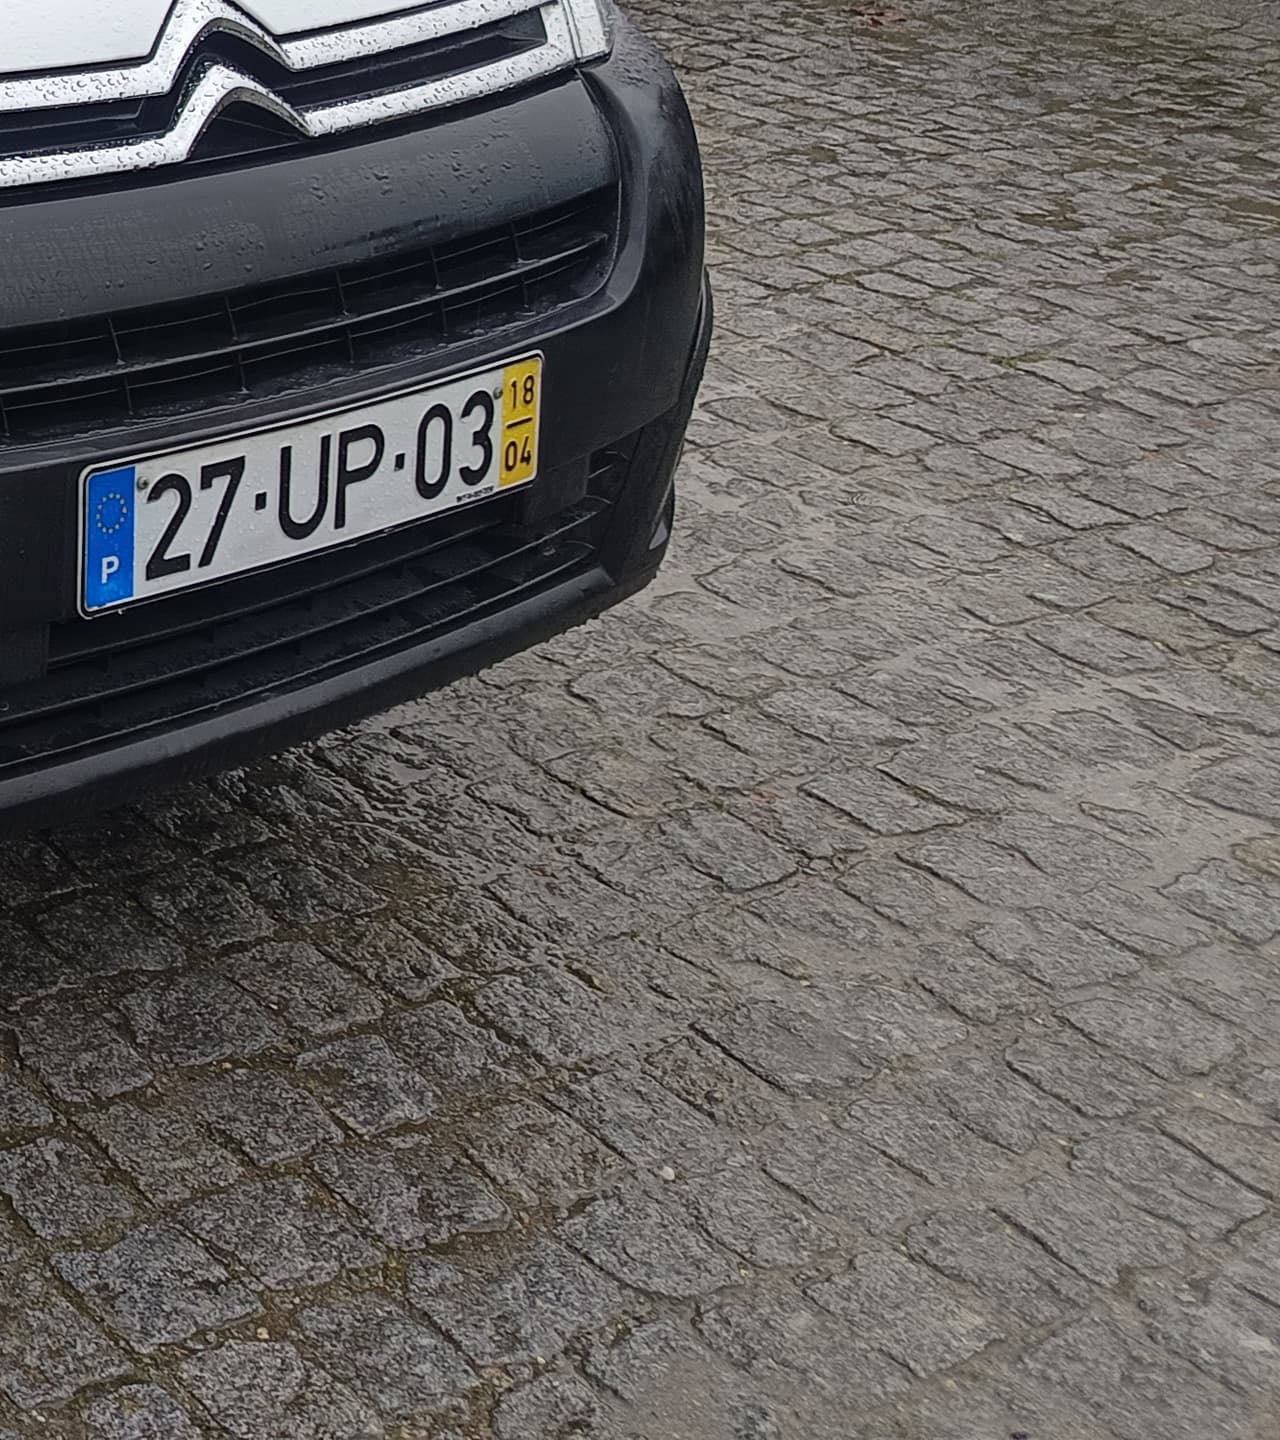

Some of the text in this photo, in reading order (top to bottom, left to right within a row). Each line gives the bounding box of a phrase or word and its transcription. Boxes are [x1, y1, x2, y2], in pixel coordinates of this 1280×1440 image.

[510, 374, 535, 408] 18
[504, 435, 533, 472] 04
[101, 555, 120, 584] P
